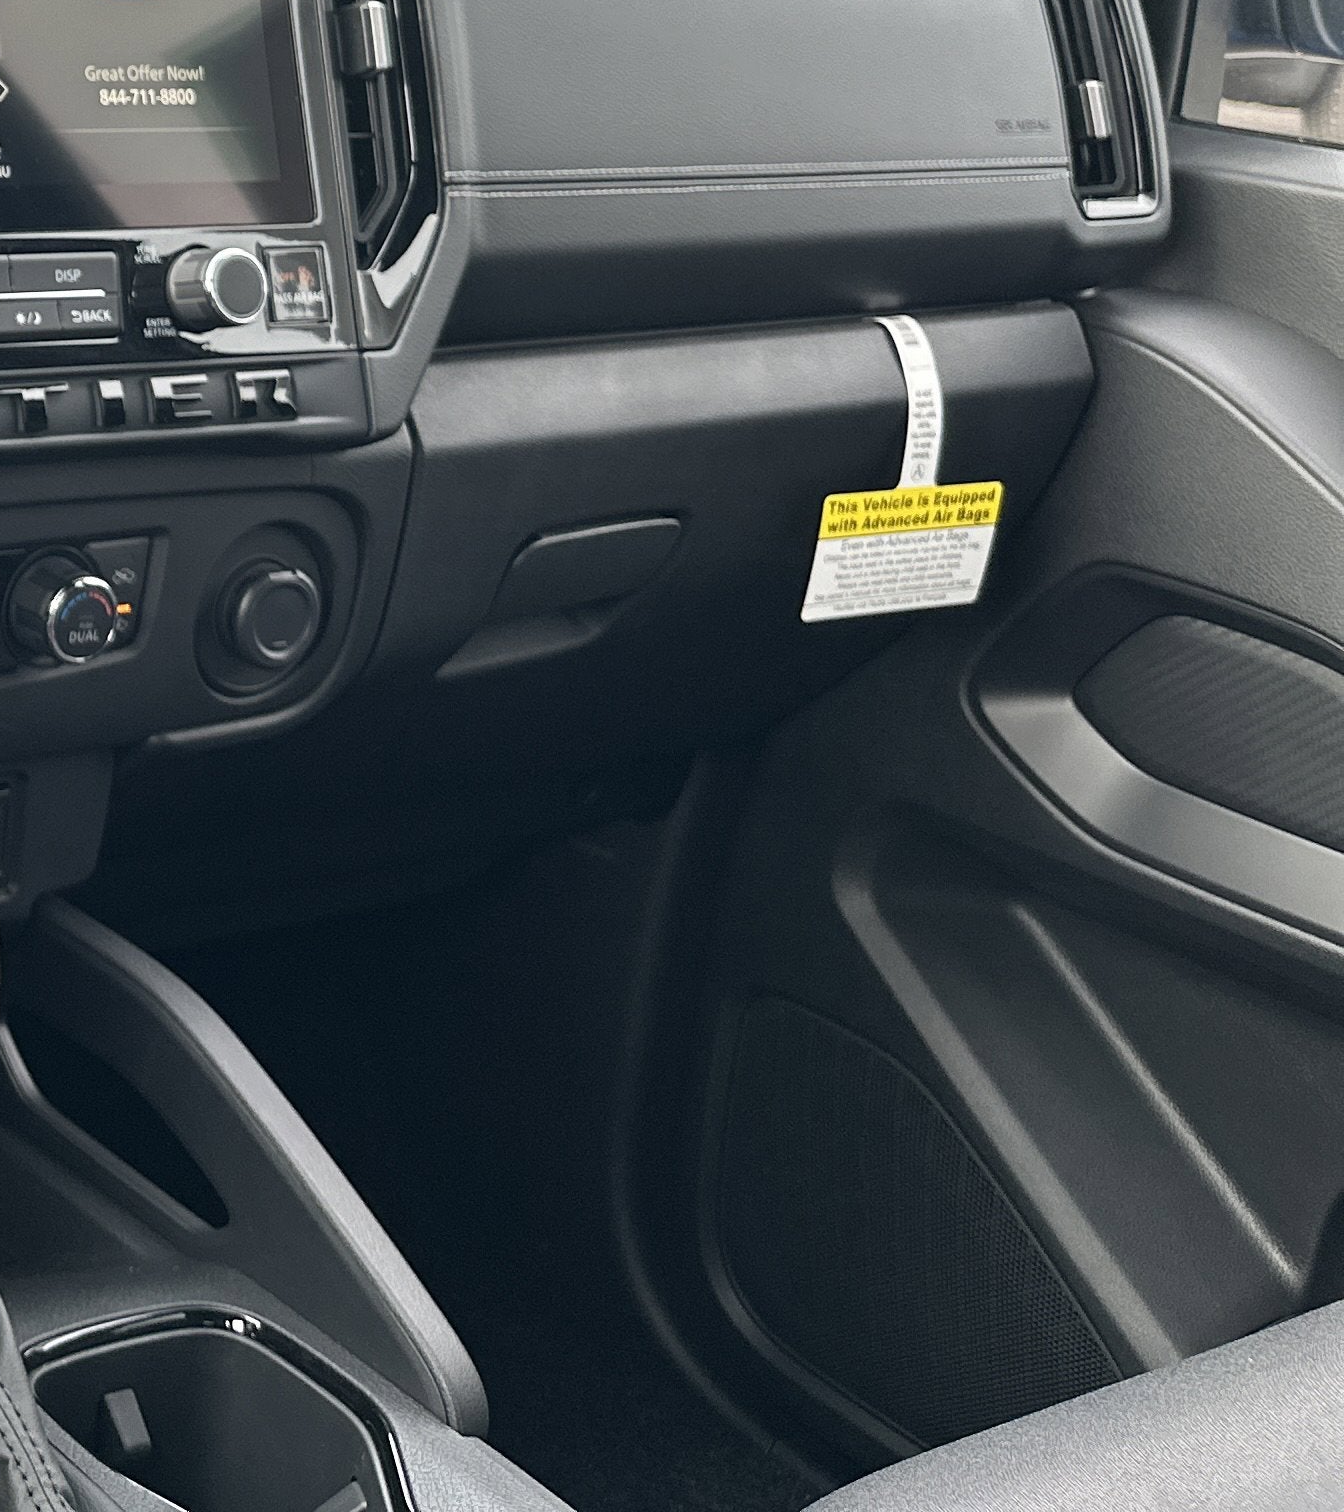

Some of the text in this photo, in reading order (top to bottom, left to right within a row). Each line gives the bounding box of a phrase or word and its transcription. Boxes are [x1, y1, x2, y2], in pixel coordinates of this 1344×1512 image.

[84, 65, 205, 82] Great Offer Now!
[99, 88, 197, 106] 844-711-8800
[55, 269, 81, 283] DISP
[82, 309, 112, 323] BACK
[829, 488, 996, 515] This Vehicle is Equipped
[828, 506, 990, 533] with Advanced Air Bags
[68, 630, 99, 644] DUAL
